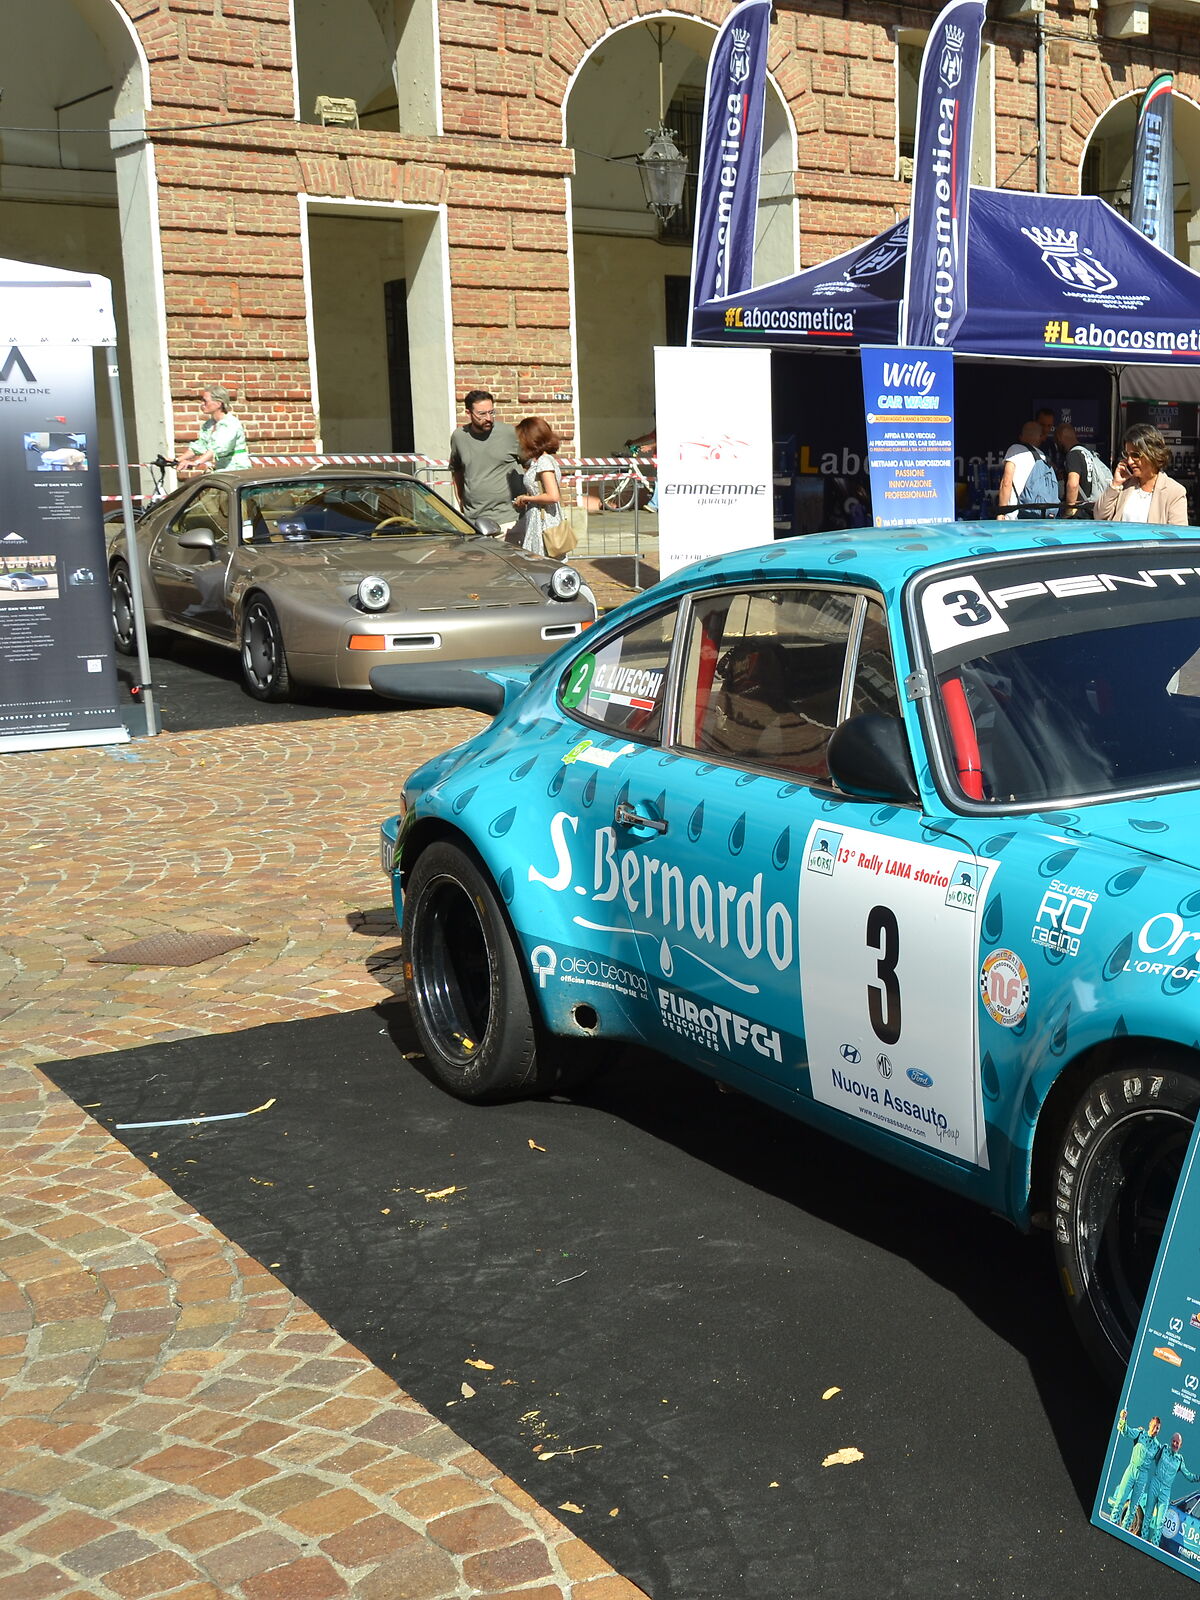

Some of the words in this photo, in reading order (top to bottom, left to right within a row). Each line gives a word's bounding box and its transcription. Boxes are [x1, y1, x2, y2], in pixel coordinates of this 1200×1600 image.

[725, 307, 854, 330] #Labocosmetica
[883, 360, 936, 395] Willy
[878, 395, 903, 409] CAR
[904, 395, 940, 410] WASH
[889, 480, 932, 488] INNOVAZIONE
[895, 469, 925, 477] PASSIONE
[884, 489, 938, 499] PROFESSIONALITÀ
[943, 590, 993, 627] 3
[572, 664, 588, 693] 2
[607, 666, 664, 698] LIVECCHI
[816, 855, 831, 871] ORSI
[837, 848, 856, 864] 13°
[857, 854, 883, 876] Rally
[885, 859, 911, 879] LANA
[913, 868, 949, 888] storico
[956, 892, 975, 907] ORSI
[1049, 879, 1099, 902] Scuderia
[1036, 890, 1093, 935] RO
[1032, 925, 1081, 957] racing
[866, 905, 902, 1045] 3
[658, 987, 783, 1063] EUROTECH
[661, 1009, 718, 1043] HELICOPTER
[662, 1018, 720, 1052] SERVICES
[832, 1068, 879, 1104] Nuova
[884, 1088, 948, 1130] Assauto
[858, 1106, 927, 1138] www.nuovaassauto.com
